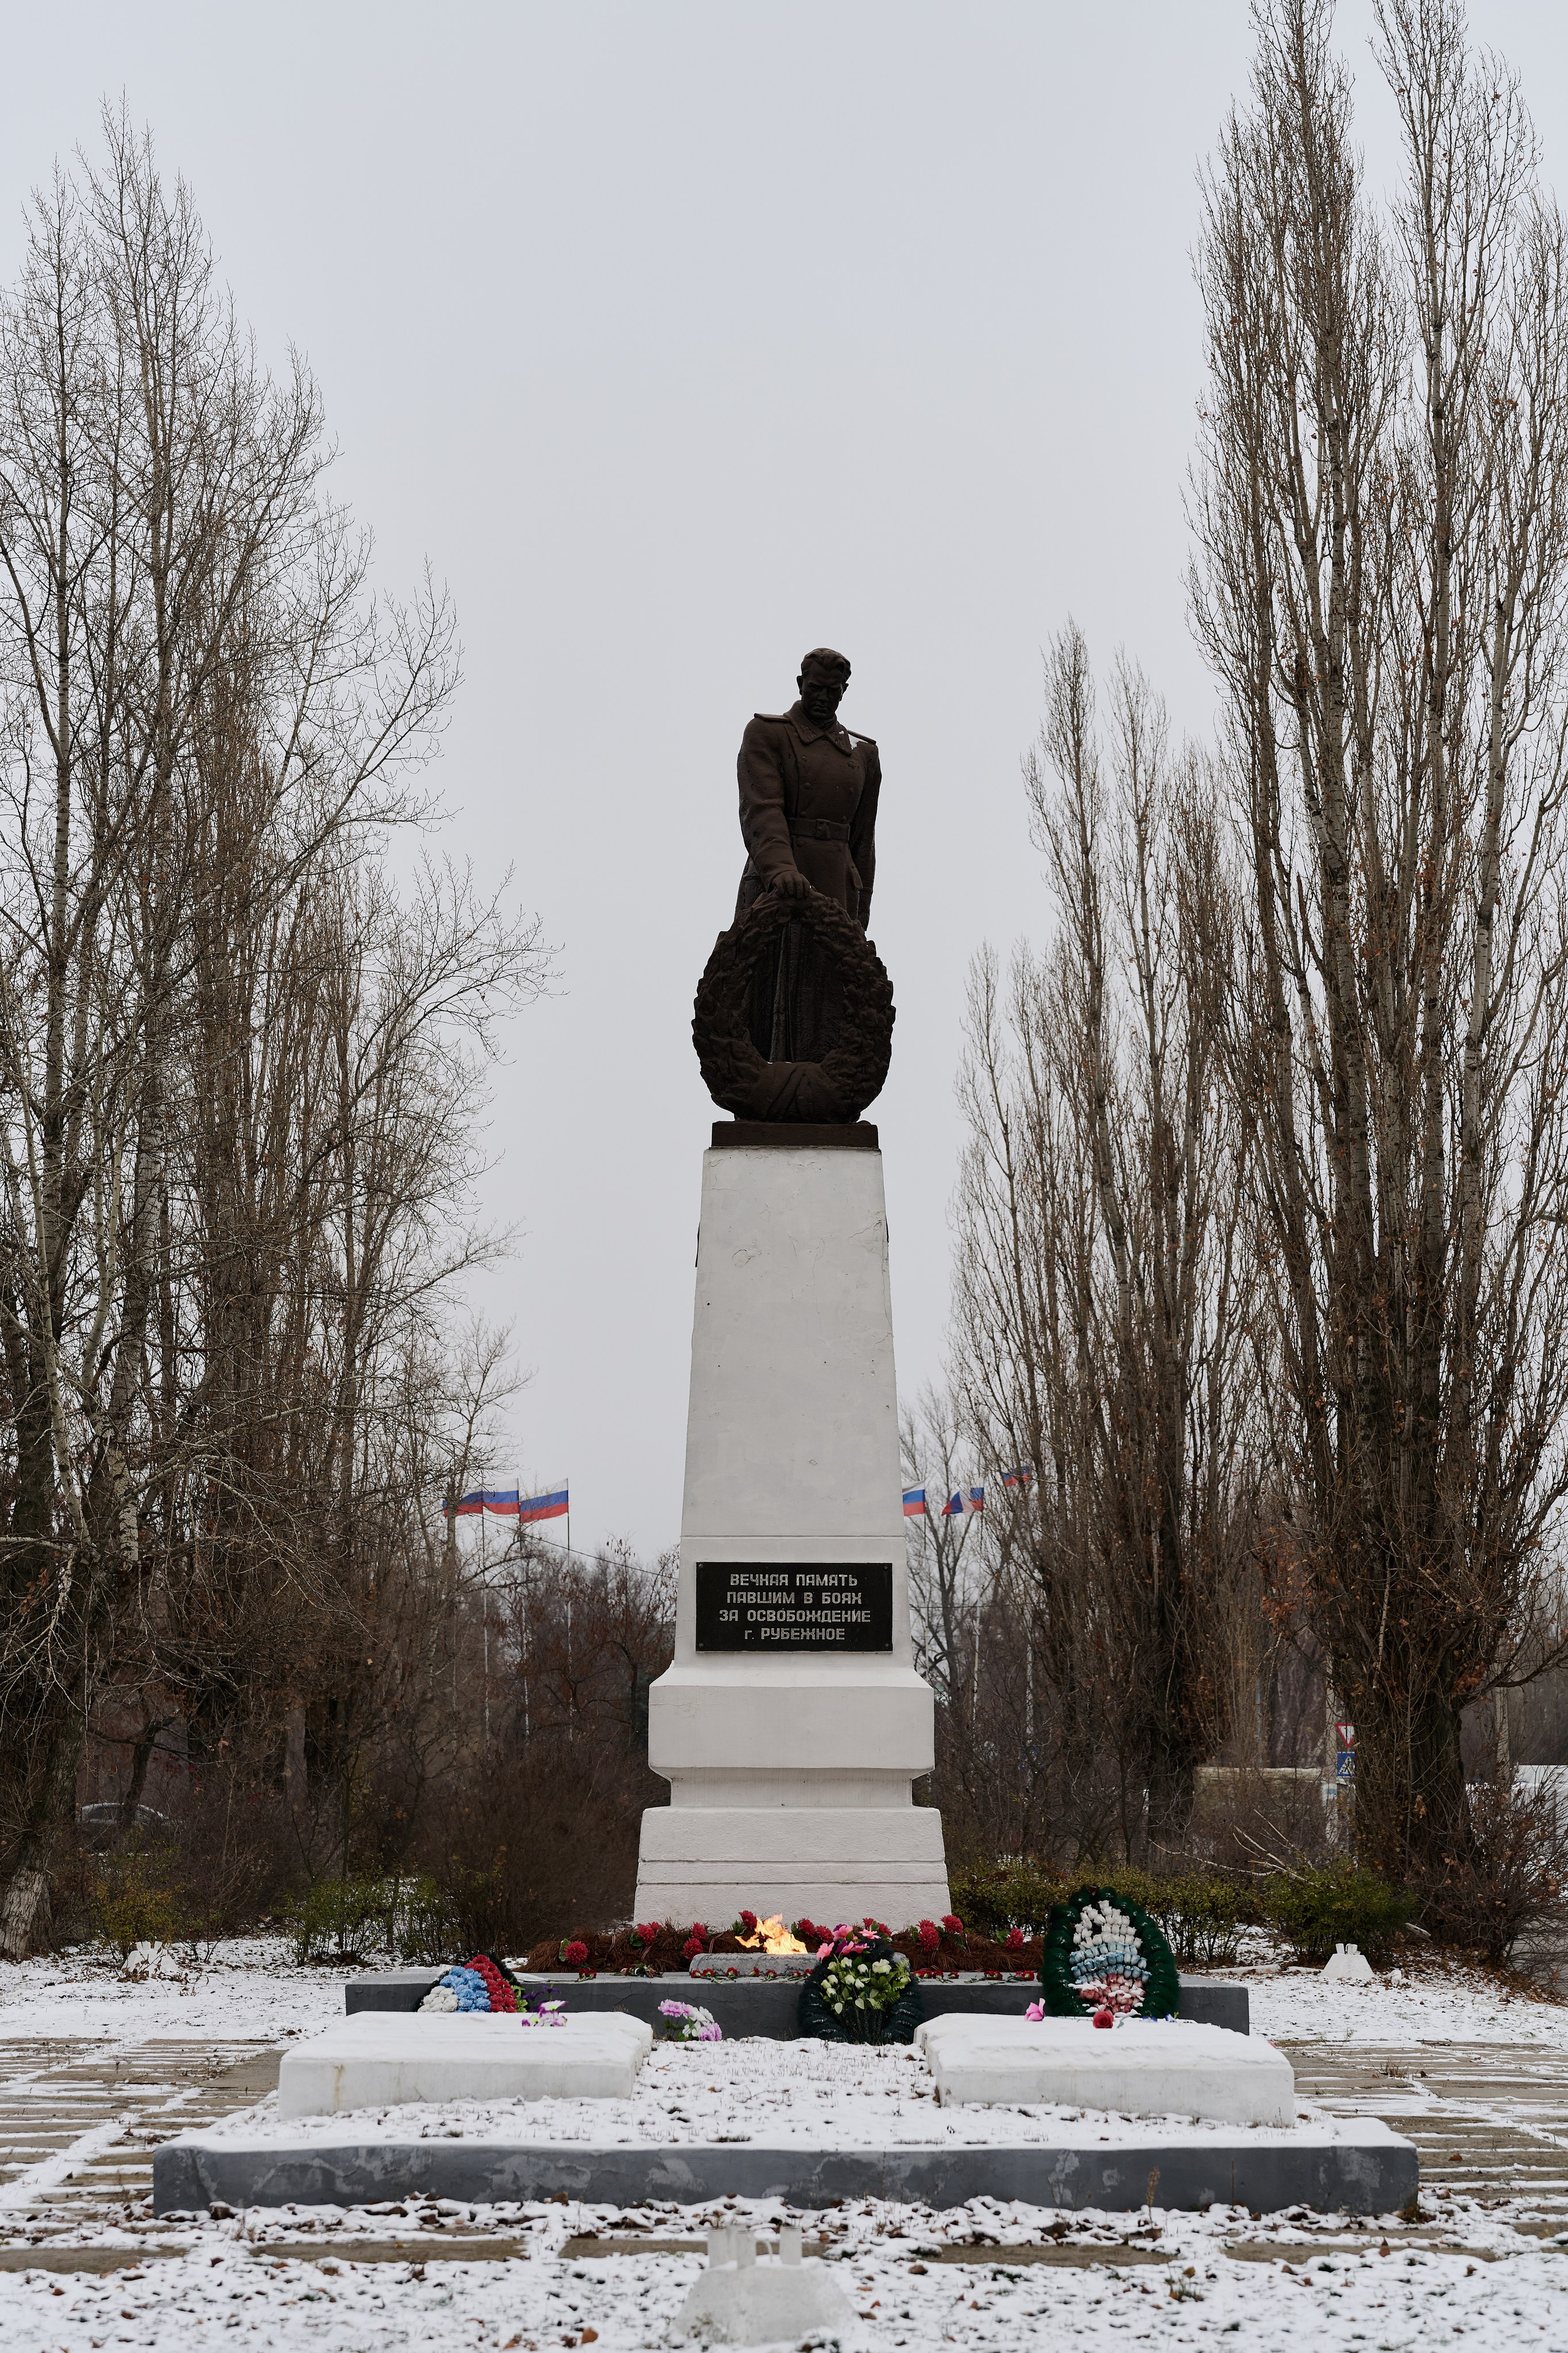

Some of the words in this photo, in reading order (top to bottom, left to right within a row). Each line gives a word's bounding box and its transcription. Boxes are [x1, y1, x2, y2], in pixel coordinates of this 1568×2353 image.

[730, 1574, 788, 1586] ВЕЧНАЯ
[796, 1574, 858, 1586] ПАМЯТЬ
[727, 1592, 795, 1604] ПАВШИМ
[804, 1592, 813, 1604] В
[821, 1592, 862, 1604] БОЯХ
[719, 1609, 739, 1622] ЗА
[747, 1609, 870, 1623] ОСВОБОЖДЕНИЕ
[761, 1628, 845, 1640] РУБЕЖНОЕ
